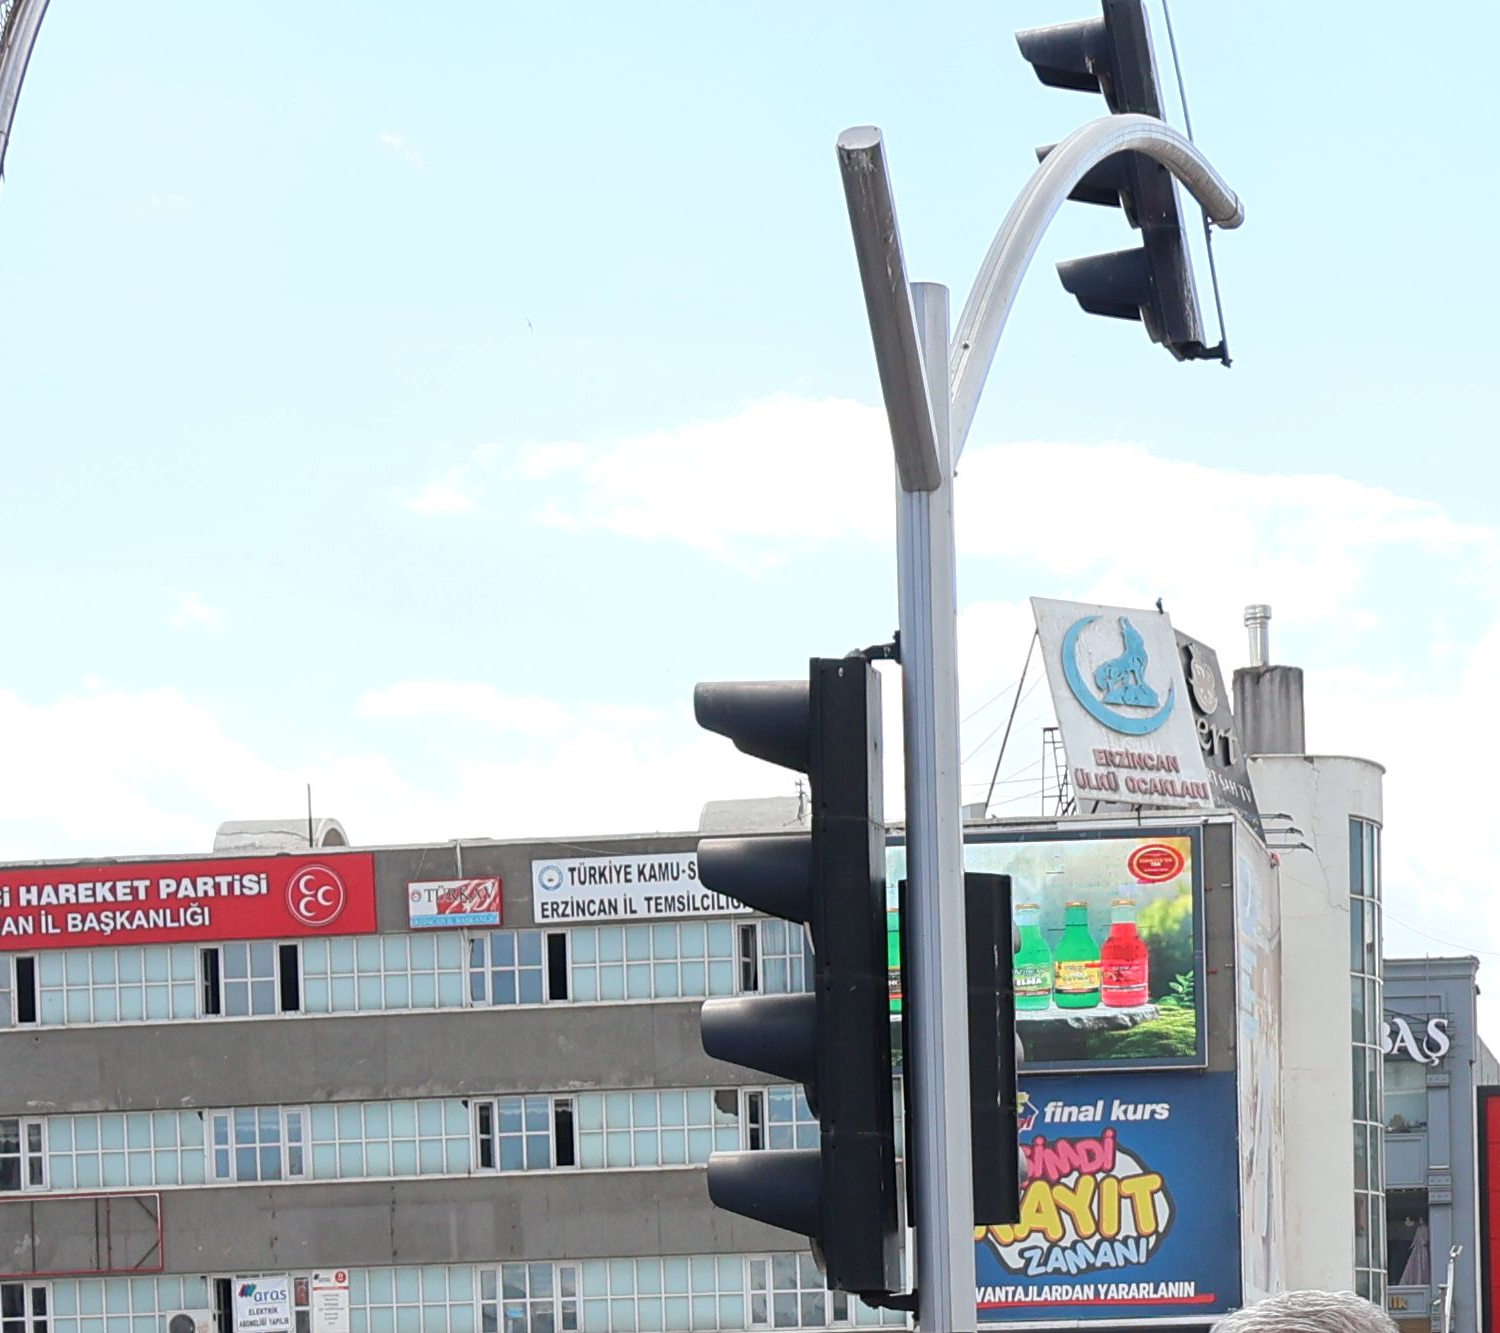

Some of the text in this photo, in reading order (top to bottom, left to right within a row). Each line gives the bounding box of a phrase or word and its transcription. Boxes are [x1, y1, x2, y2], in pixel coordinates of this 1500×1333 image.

[1093, 748, 1180, 773] ERZİNCAN
[1075, 768, 1209, 800] ÜLKÜ OCAKLARI
[568, 860, 700, 886] TÜRKİYE KAMU-S
[20, 873, 268, 908] HAREKET PARTİSİ
[541, 893, 637, 919] ERZİNCAN İL
[40, 912, 61, 935] İL
[67, 903, 210, 937] BAŞKANLIĞI
[1044, 1100, 1170, 1123] final kurs
[1023, 1237, 1147, 1276] ZAMANI
[254, 1289, 287, 1302] aras
[976, 1282, 1195, 1302] VANTAJLARDAN YARARLANIN
[248, 1307, 278, 1316] ELEKTRİK
